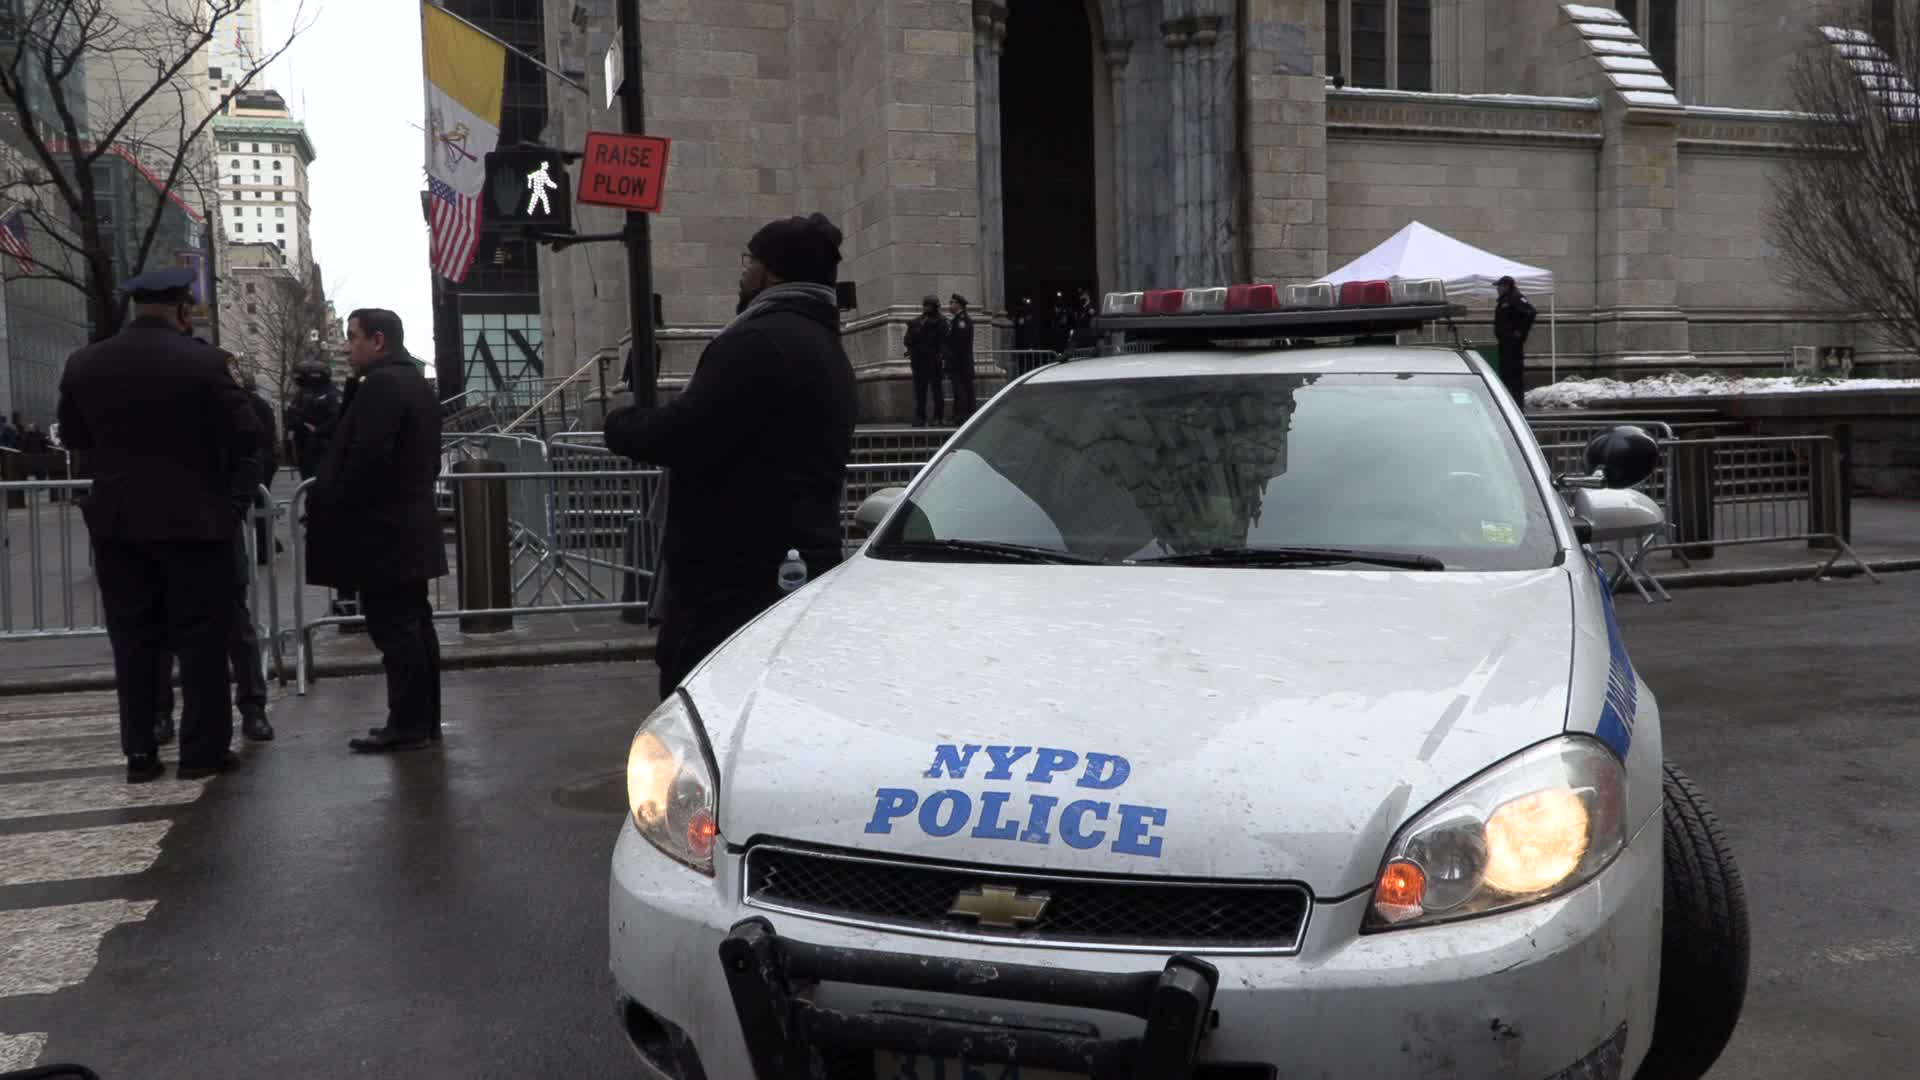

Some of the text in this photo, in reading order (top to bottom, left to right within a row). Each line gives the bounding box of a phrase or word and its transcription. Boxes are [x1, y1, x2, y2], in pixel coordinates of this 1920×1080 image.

[594, 143, 654, 168] RAISE
[593, 172, 647, 197] PLOW
[923, 744, 1131, 790] NYPD
[864, 788, 1167, 858] POLICE
